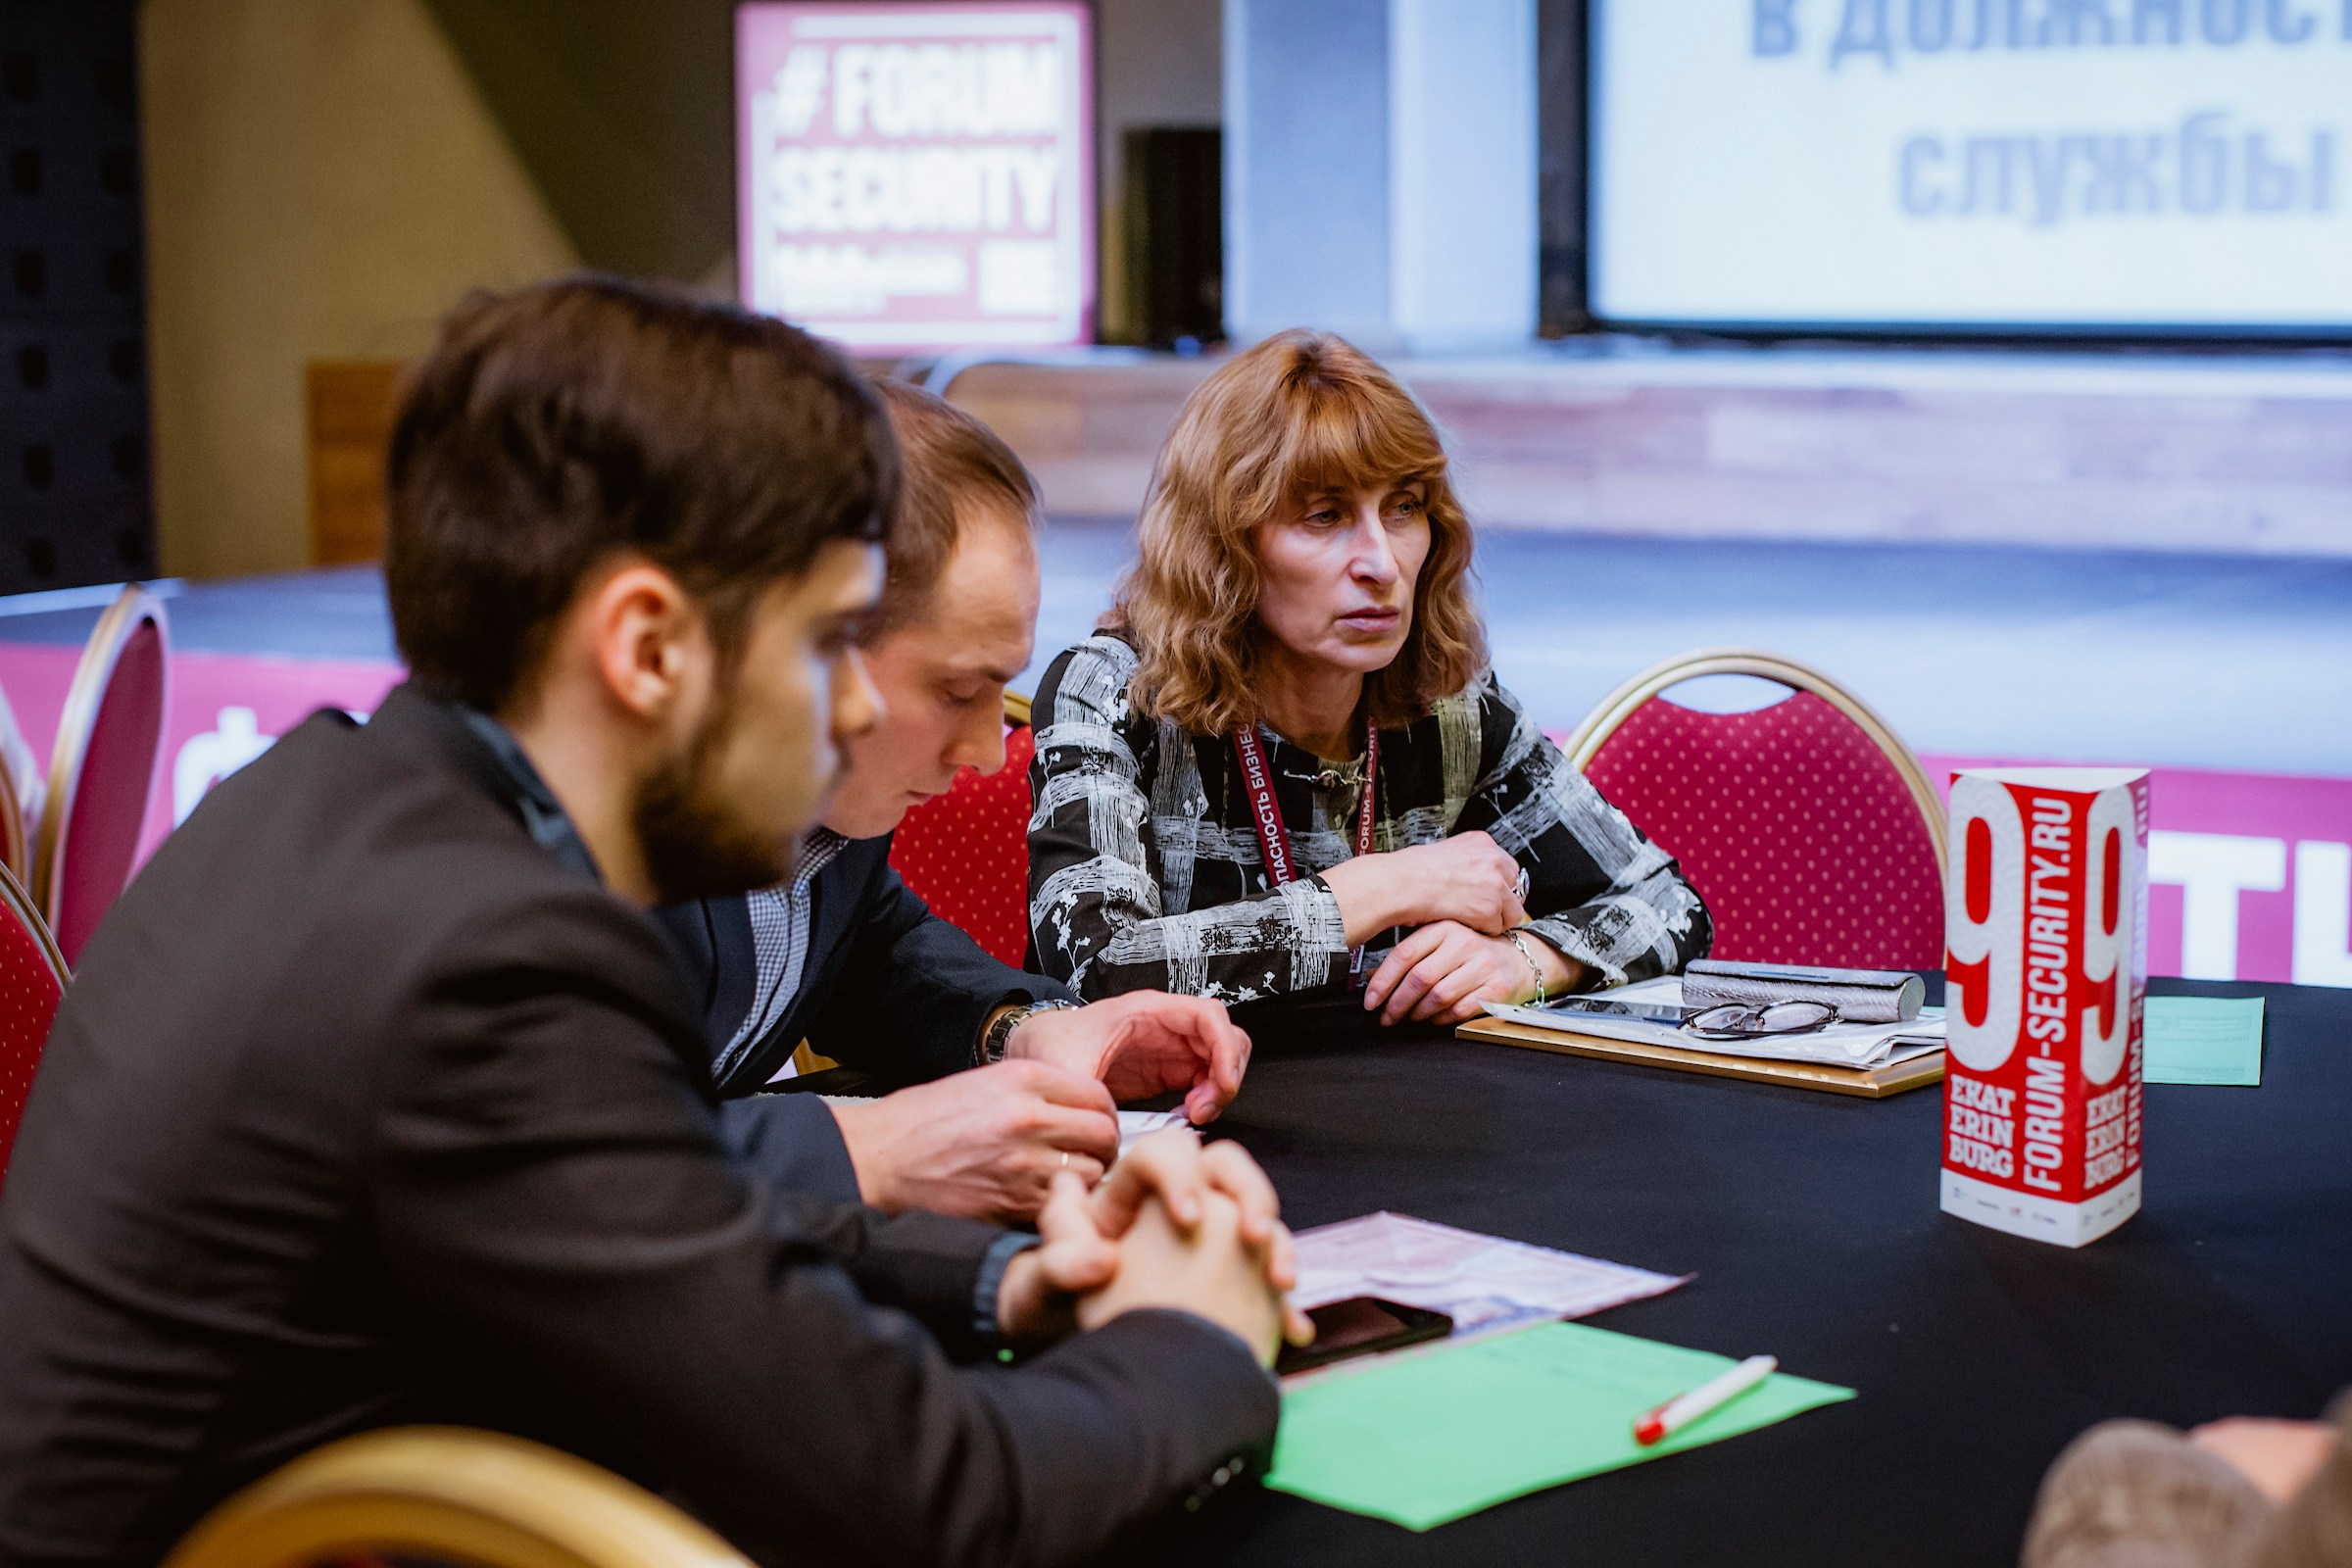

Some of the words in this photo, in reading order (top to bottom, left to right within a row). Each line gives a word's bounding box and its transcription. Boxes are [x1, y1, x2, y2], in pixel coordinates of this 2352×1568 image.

[1828, 0, 2352, 72] должнос
[1945, 775, 2026, 1071] 9
[2081, 784, 2136, 1085] 9
[2023, 797, 2073, 1192] FORUM-SECURITY.RU
[1949, 1102, 2015, 1150] ERIN
[1950, 1073, 2016, 1117] EKAT
[1948, 1132, 2014, 1178] BURG
